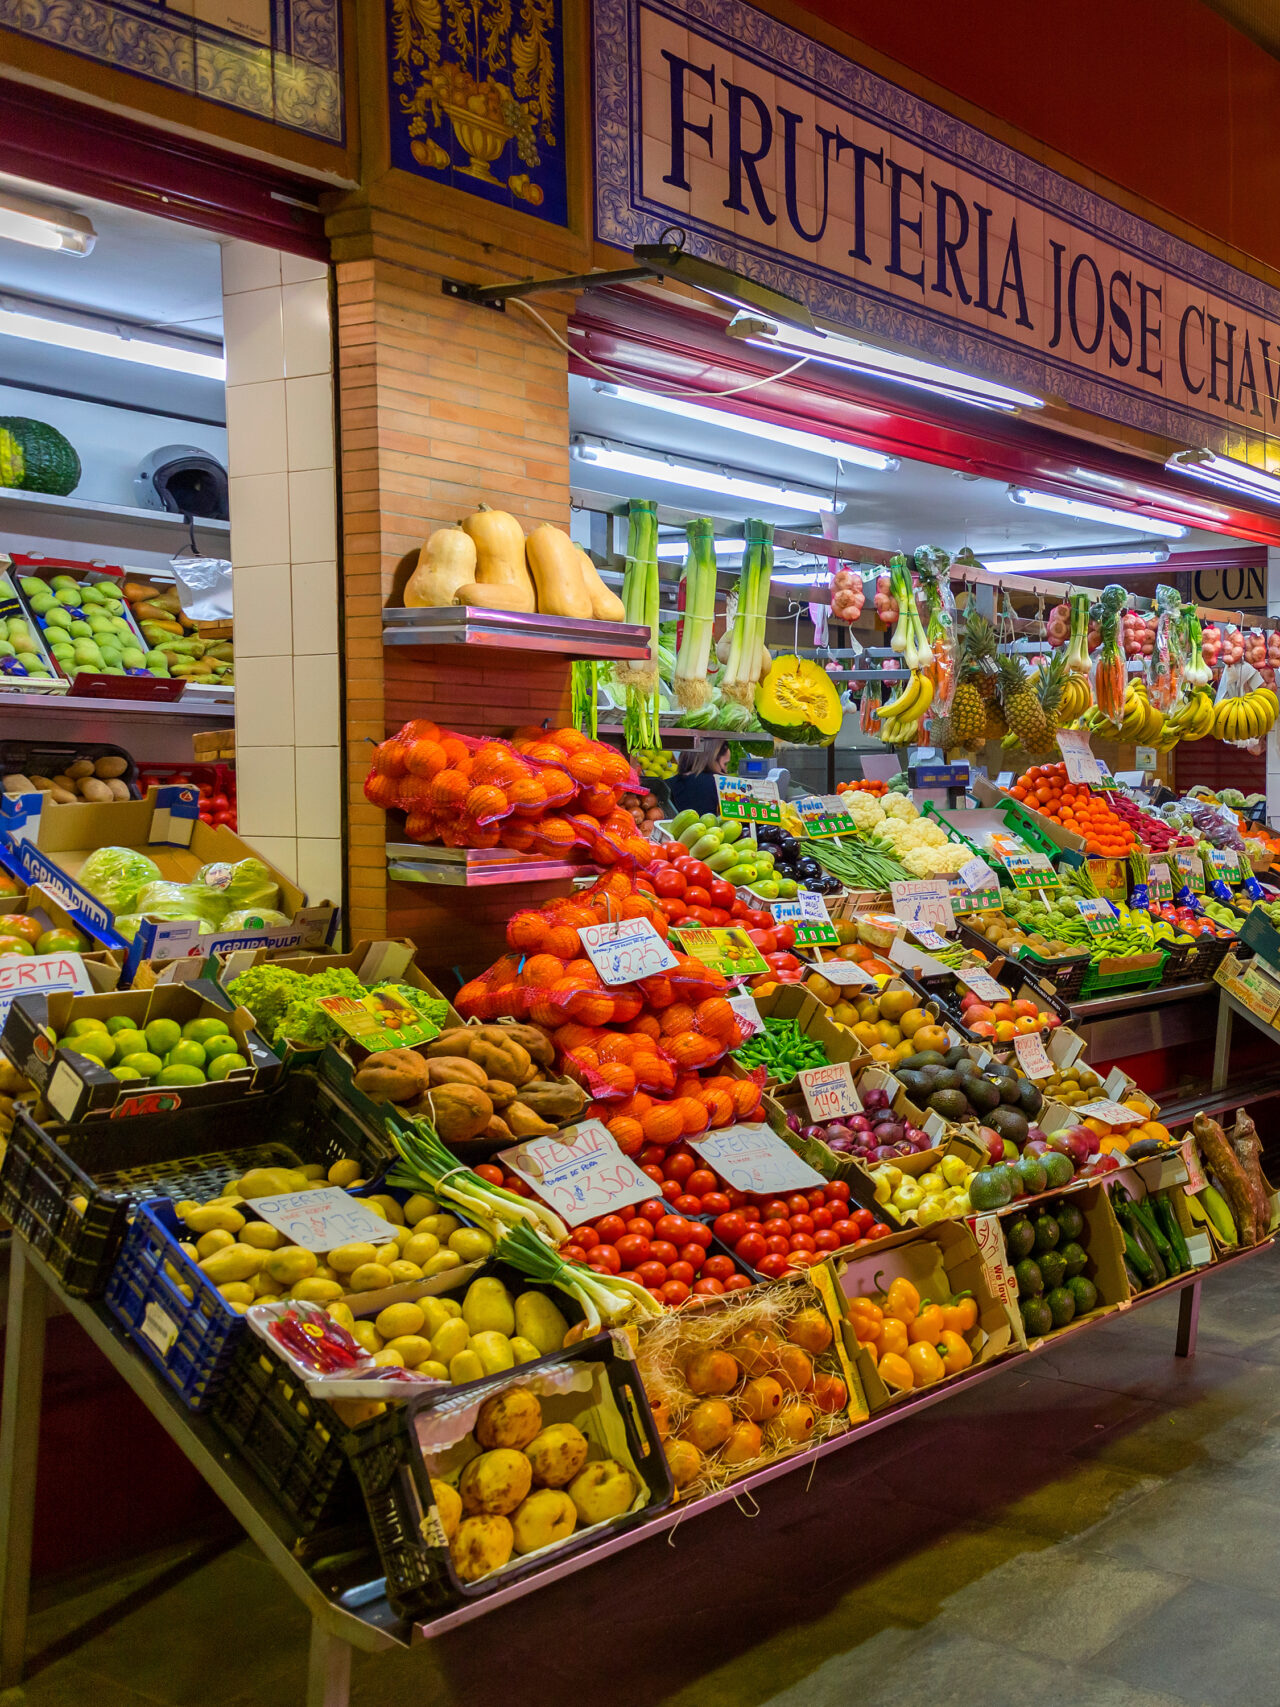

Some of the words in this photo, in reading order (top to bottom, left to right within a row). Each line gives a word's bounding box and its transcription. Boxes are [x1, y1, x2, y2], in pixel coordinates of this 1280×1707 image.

[661, 48, 1032, 329] FRUTERIA
[1047, 239, 1164, 382] JOSE
[719, 776, 752, 793] Fruta
[774, 905, 801, 919] Fruta
[586, 920, 651, 947] OFERTA
[804, 1066, 845, 1087] OFERTA
[516, 1128, 614, 1177] OFERTA
[258, 1191, 339, 1213] OFERTA
